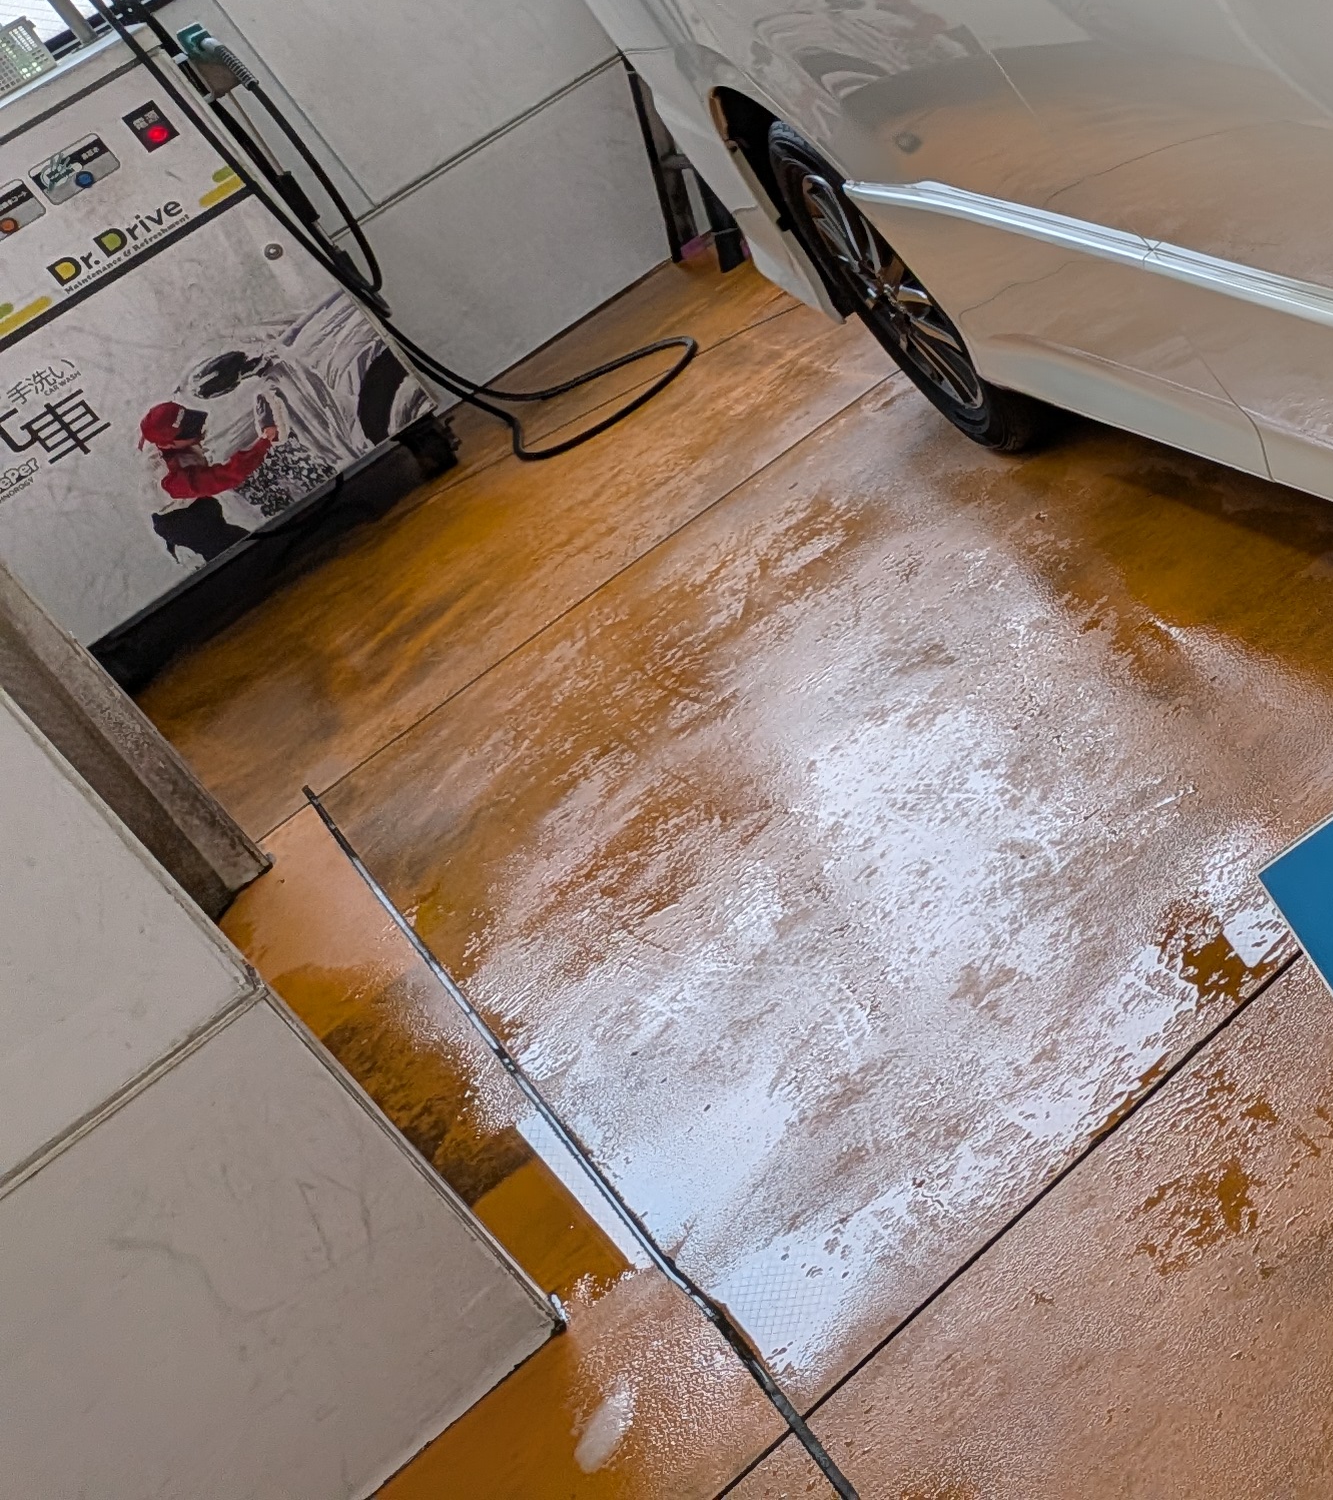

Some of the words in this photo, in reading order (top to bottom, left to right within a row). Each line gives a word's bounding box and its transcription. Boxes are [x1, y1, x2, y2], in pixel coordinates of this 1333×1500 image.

[65, 254, 122, 295] Maintenance
[132, 213, 190, 253] Refreshment
[6, 359, 75, 405] 手洗い
[44, 384, 59, 396] CAR
[59, 370, 81, 387] WASH
[0, 388, 111, 465] 車
[0, 457, 39, 494] ePer
